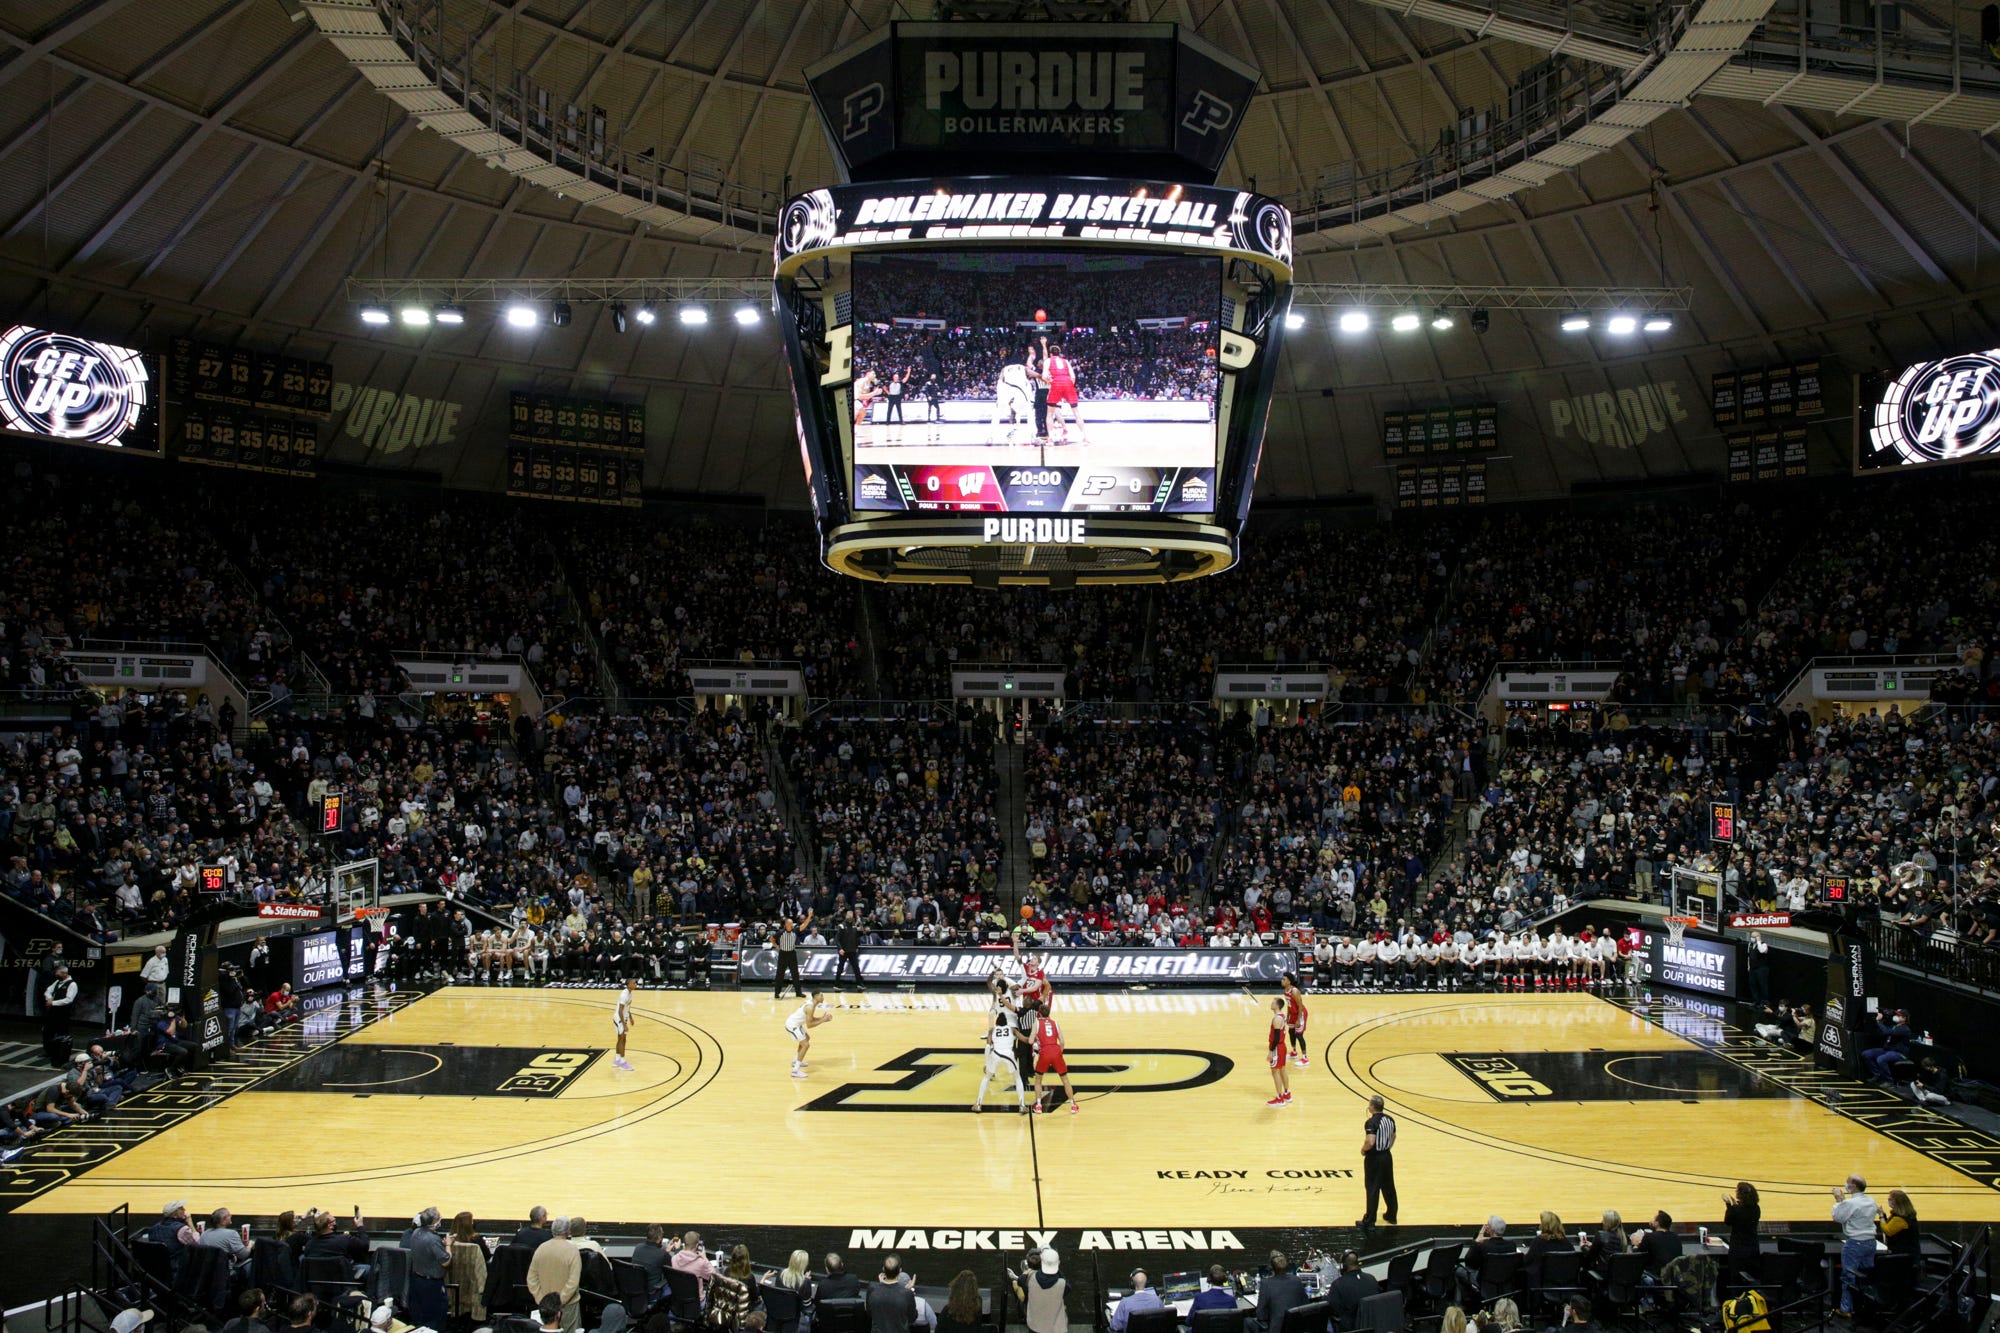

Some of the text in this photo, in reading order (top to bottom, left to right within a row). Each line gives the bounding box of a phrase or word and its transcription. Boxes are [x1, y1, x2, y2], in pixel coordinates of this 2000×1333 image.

[925, 51, 1145, 110] PURDUE
[844, 81, 884, 142] P
[1180, 90, 1233, 137] P
[944, 116, 1126, 134] BOILERMAKERS
[854, 193, 1217, 228] BOILERMAKER BASKETBALL
[33, 348, 100, 381] GET
[198, 358, 223, 378] 27
[230, 363, 249, 383] 13
[262, 369, 275, 386] 7
[282, 373, 305, 391] 23
[1925, 365, 1994, 405] GET
[309, 378, 331, 395] 37
[24, 377, 91, 417] UP
[331, 382, 463, 454] PURDUE
[513, 404, 529, 421] 10
[534, 407, 553, 424] 22
[557, 410, 577, 427] 23
[580, 413, 599, 429] 33
[1550, 380, 1688, 449] PURDUE
[1917, 397, 1983, 444] UP
[185, 421, 205, 441] 19
[603, 415, 622, 431] 55
[627, 417, 642, 434] 13
[210, 425, 235, 445] 32
[240, 430, 263, 448] 35
[267, 433, 289, 452] 43
[293, 438, 316, 456] 42
[1456, 440, 1473, 448] 1940
[512, 461, 524, 477] 4
[532, 463, 552, 480] 25
[555, 465, 576, 482] 33
[579, 468, 598, 484] 50
[606, 470, 617, 485] 3
[1758, 469, 1778, 479] 2017
[927, 476, 940, 491] 0
[958, 472, 986, 497] W
[1010, 471, 1062, 486] 20:00
[1082, 476, 1117, 495] P
[1129, 478, 1142, 493] 0
[984, 518, 1086, 543] PURDUE
[325, 797, 340, 809] 20:00
[325, 809, 337, 829] 30
[1715, 806, 1732, 818] 20:00
[1717, 819, 1731, 838] 30
[203, 868, 223, 877] 20:00
[207, 878, 220, 888] 30
[1826, 879, 1846, 887] 20:00
[1829, 888, 1842, 899] 30
[303, 937, 327, 947] THIS IS
[1644, 935, 1652, 945] 0
[1662, 937, 1678, 946] THIS
[187, 933, 197, 986] ROHRMAN
[910, 955, 955, 974] FOR
[1103, 954, 1235, 974] BASKETBALL
[1663, 945, 1725, 972] MACKEY
[304, 963, 364, 983] OUR HOSE
[1644, 963, 1652, 974] 0
[1849, 944, 1861, 997] ROHRMAN
[1663, 969, 1725, 991] OUR HOUSE
[996, 1028, 1010, 1037] 23
[1045, 1025, 1053, 1037] 5
[202, 1035, 224, 1051] PIONEER
[1157, 1170, 1354, 1179] KEADY COURT
[848, 1230, 1245, 1249] MACKEY ARENA
